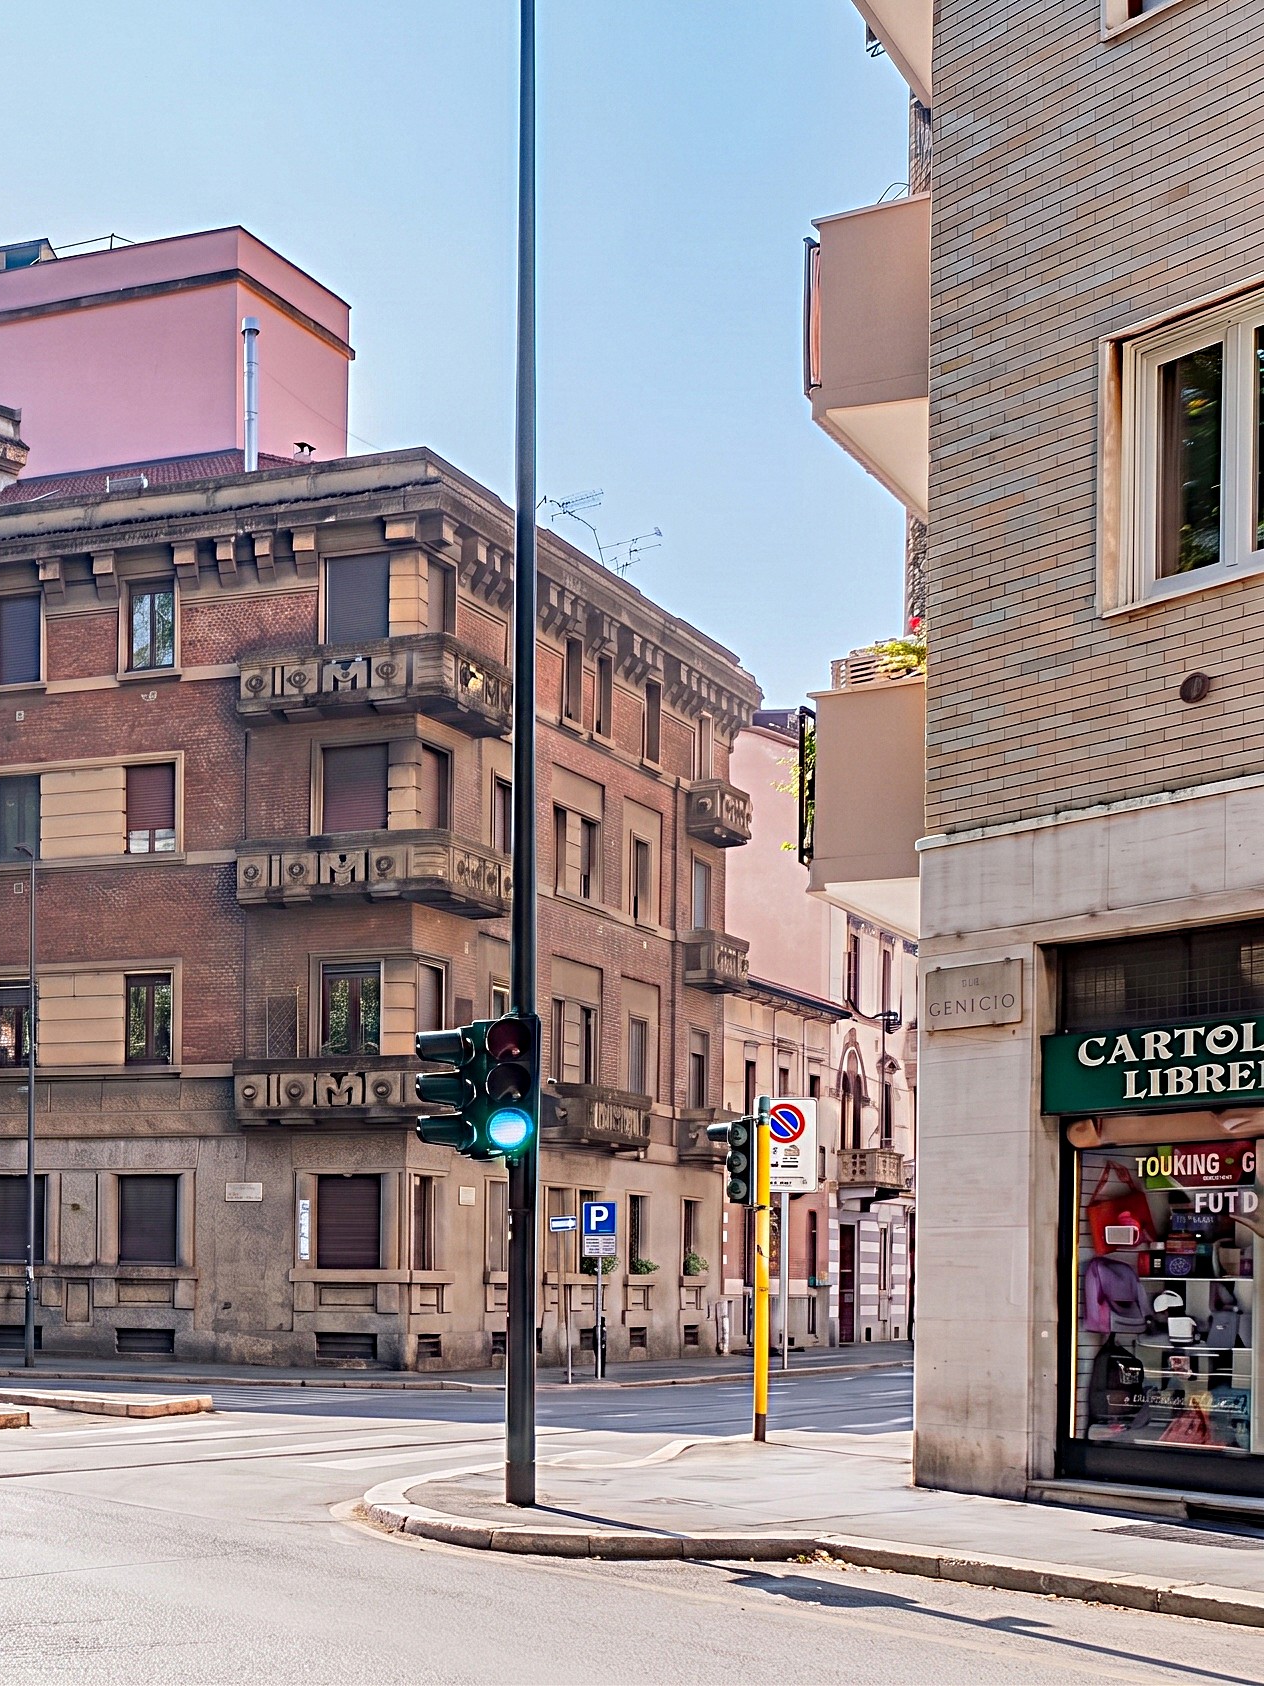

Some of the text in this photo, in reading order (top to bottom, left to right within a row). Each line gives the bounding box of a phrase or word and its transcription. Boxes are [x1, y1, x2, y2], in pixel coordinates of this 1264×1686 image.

[929, 993, 1015, 1017] GENICIO
[1077, 1021, 1264, 1067] CARTOL
[590, 1205, 609, 1231] P
